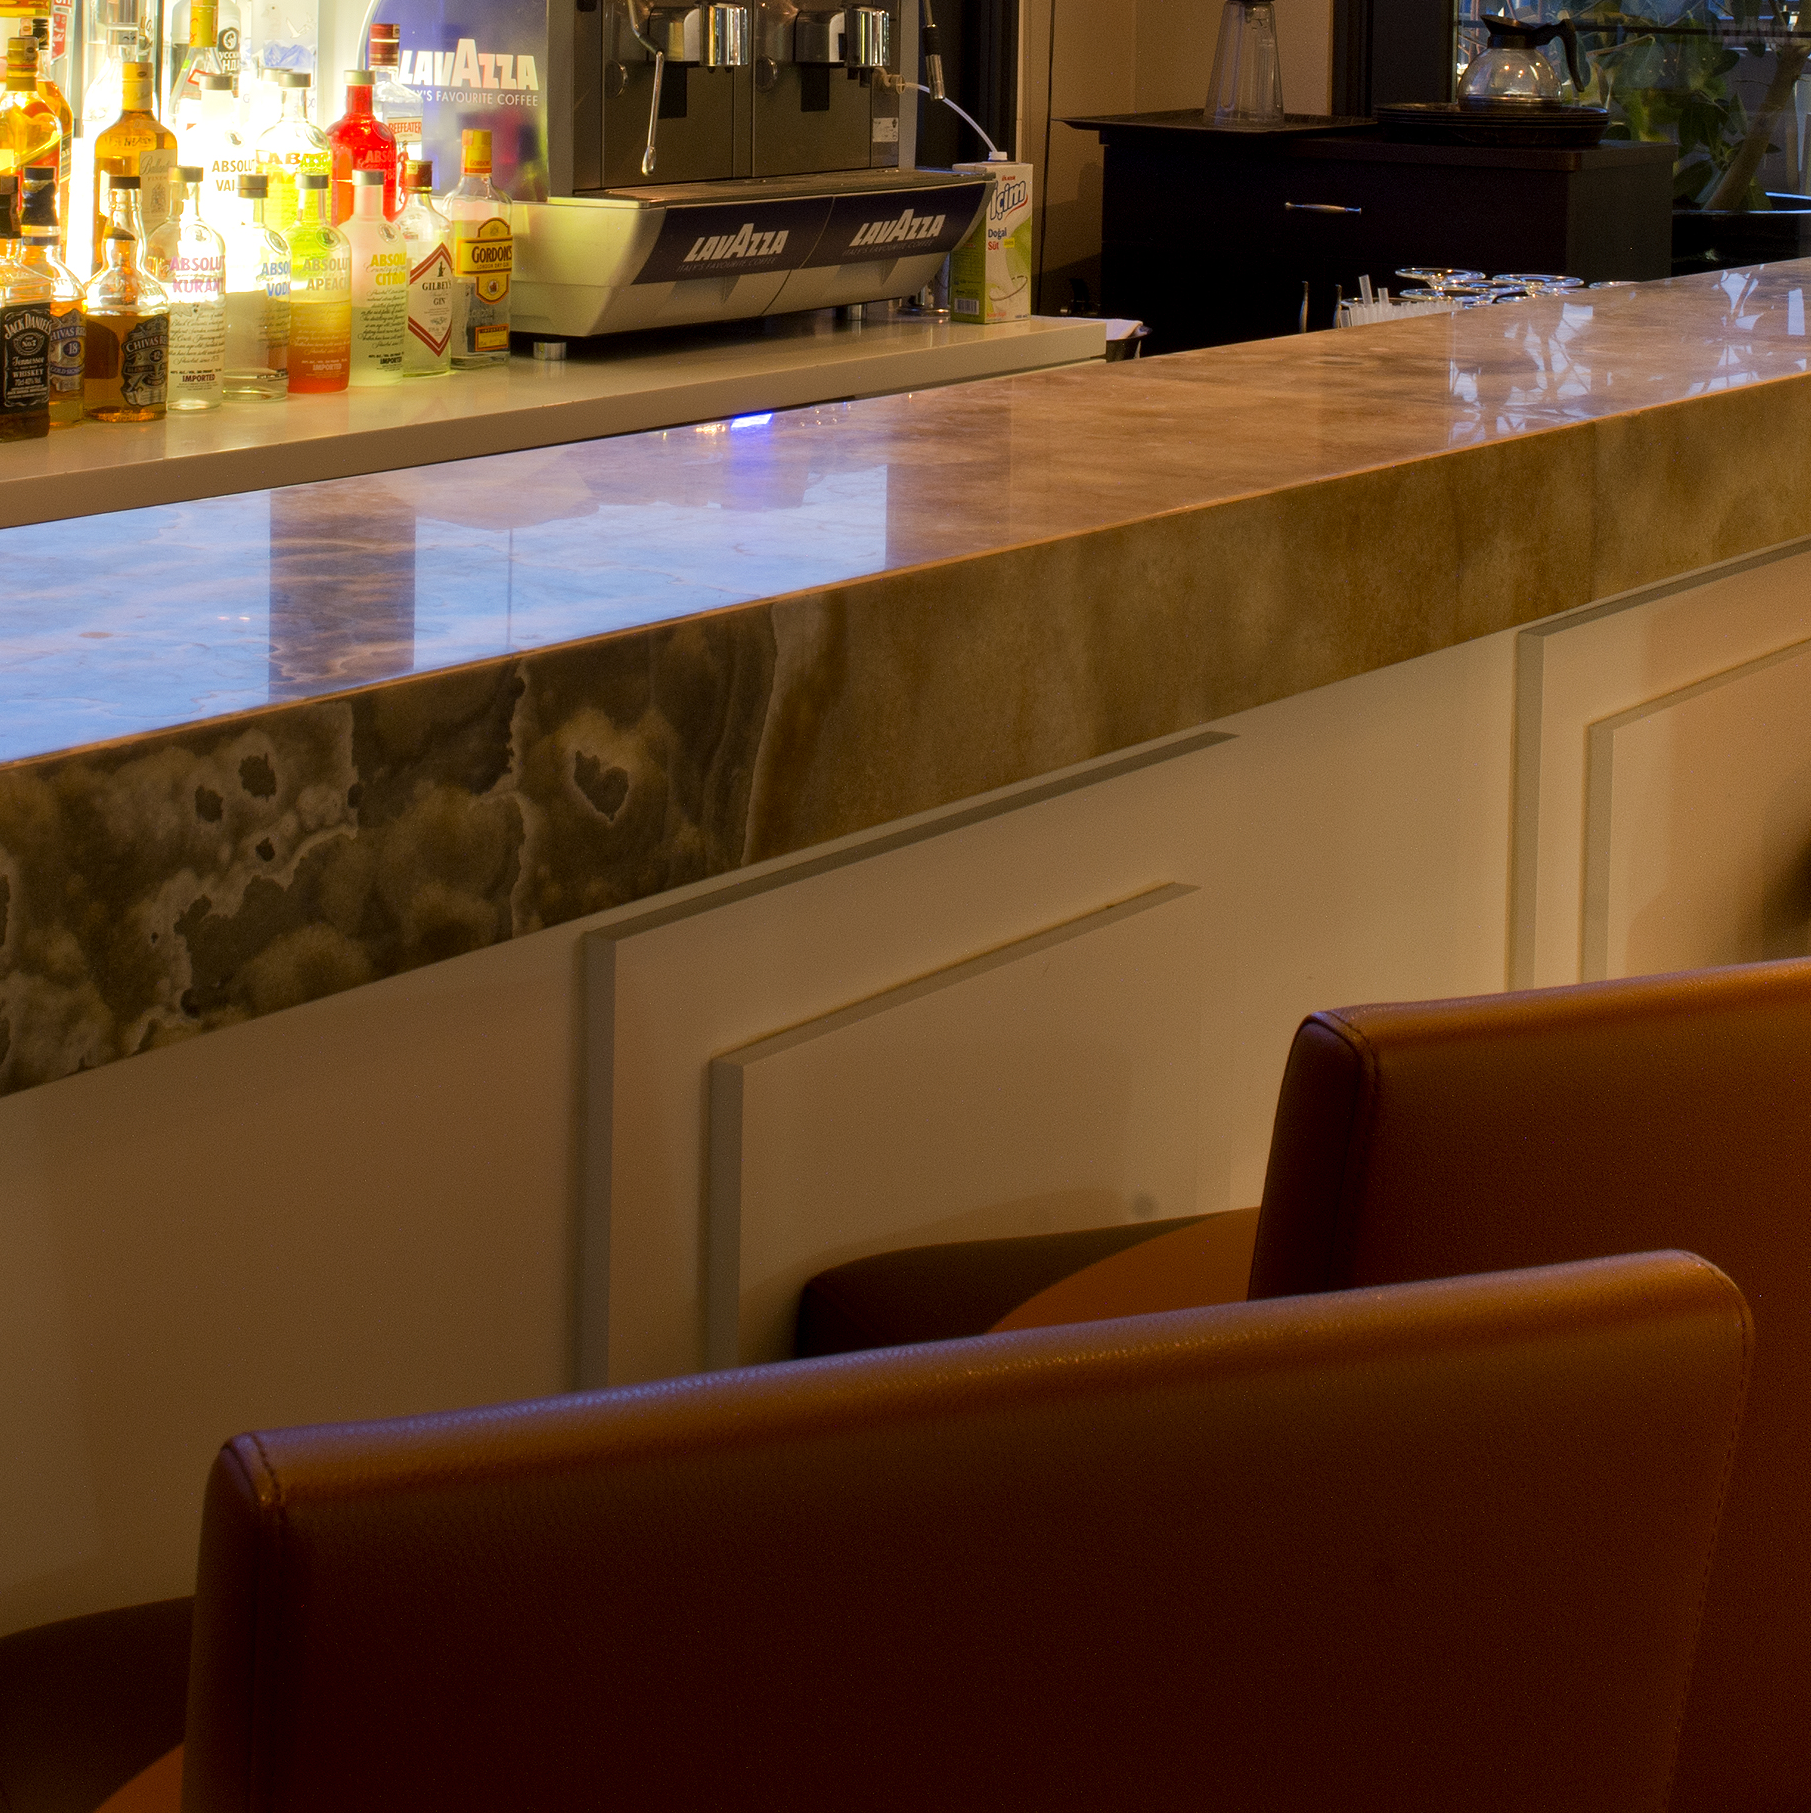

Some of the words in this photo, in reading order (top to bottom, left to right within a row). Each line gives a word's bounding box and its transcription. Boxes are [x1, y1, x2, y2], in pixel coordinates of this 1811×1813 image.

[398, 38, 539, 91] LAVAZZA
[436, 90, 493, 105] FAVOURITE
[497, 93, 539, 107] COFFEE
[848, 208, 946, 248] LAVAZZA
[987, 227, 1007, 240] Doğal
[682, 222, 789, 264] LAVAZZA
[987, 240, 999, 251] Süt
[4, 320, 26, 340] JACK
[67, 342, 79, 354] 18
[125, 338, 158, 354] CHIVAS
